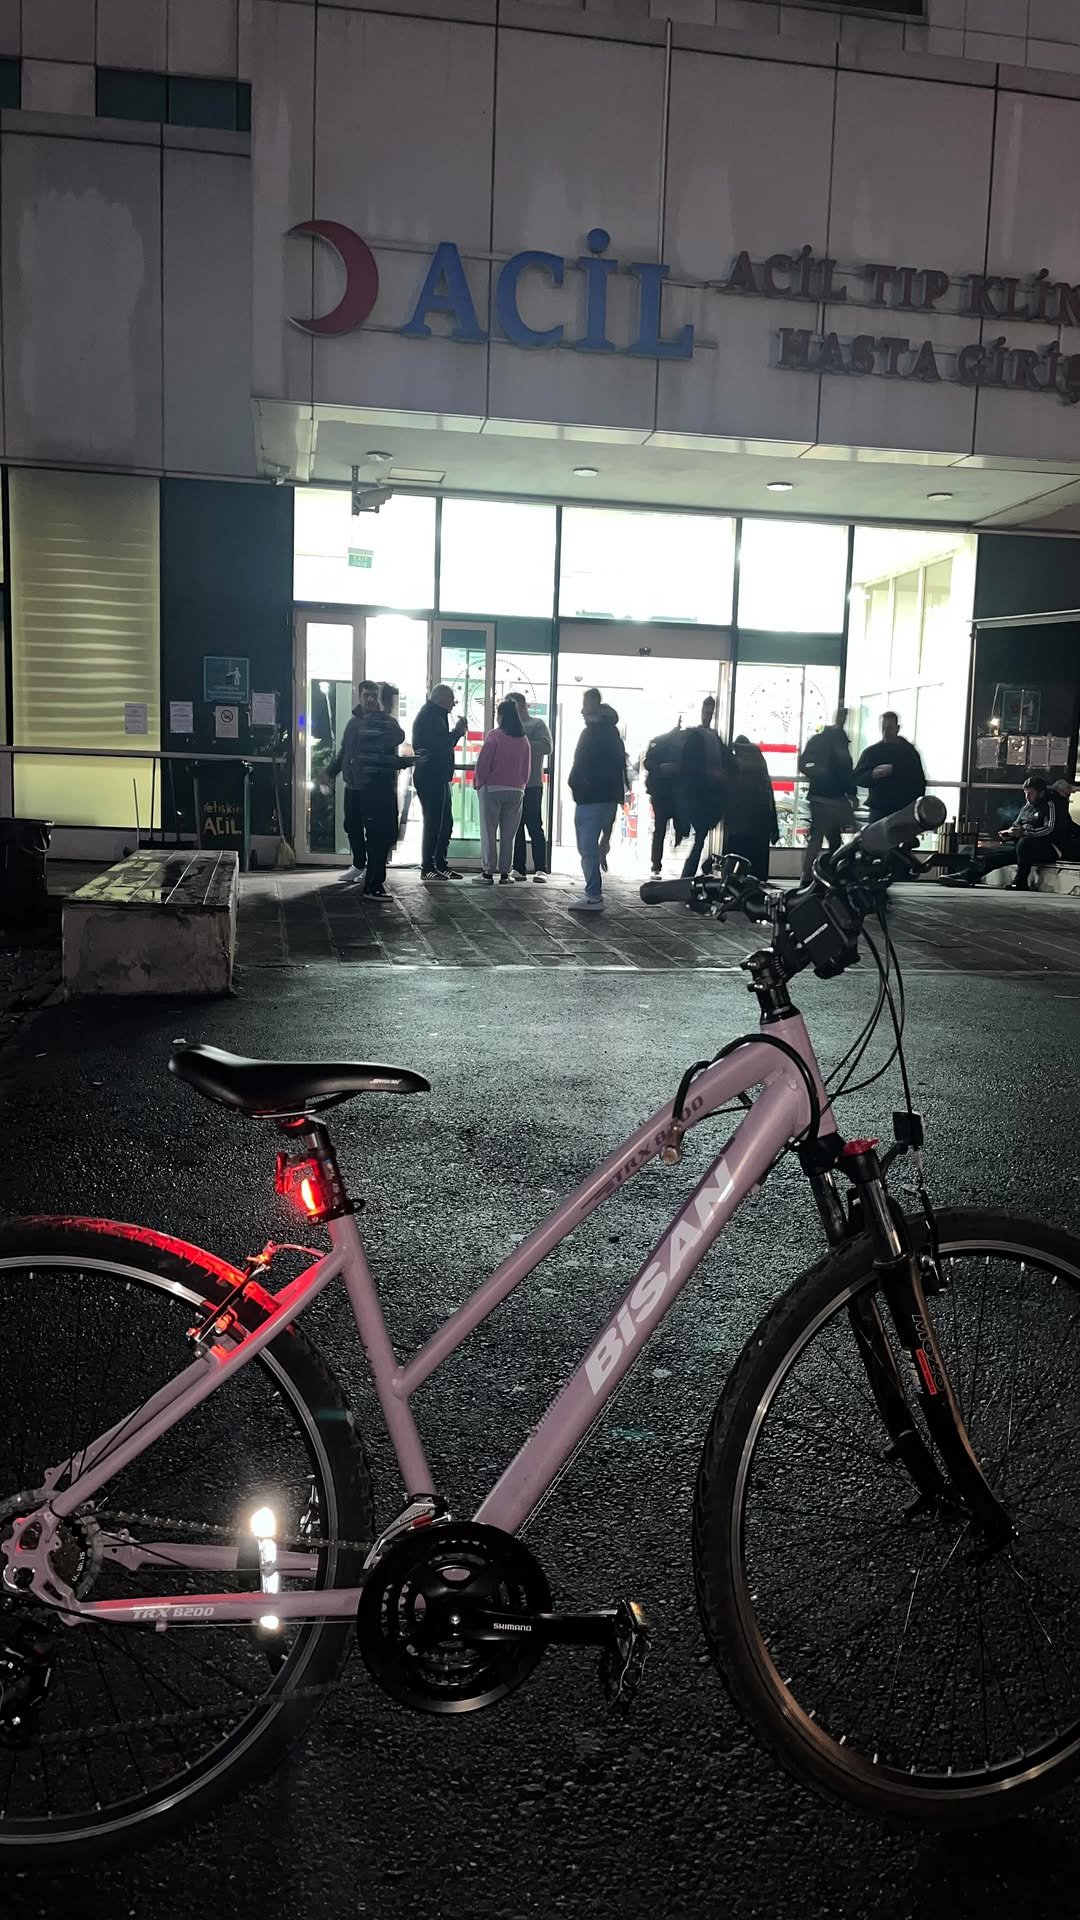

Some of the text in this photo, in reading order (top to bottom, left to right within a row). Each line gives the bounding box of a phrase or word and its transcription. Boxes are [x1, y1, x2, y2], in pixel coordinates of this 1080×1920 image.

[400, 228, 694, 360] ACİL
[718, 244, 848, 299] ACİL
[863, 263, 949, 311] TIP
[770, 327, 942, 384] HASTA
[611, 1095, 704, 1182] TRX 800
[132, 1605, 170, 1619] TRX
[493, 1622, 532, 1632] SHIMANO
